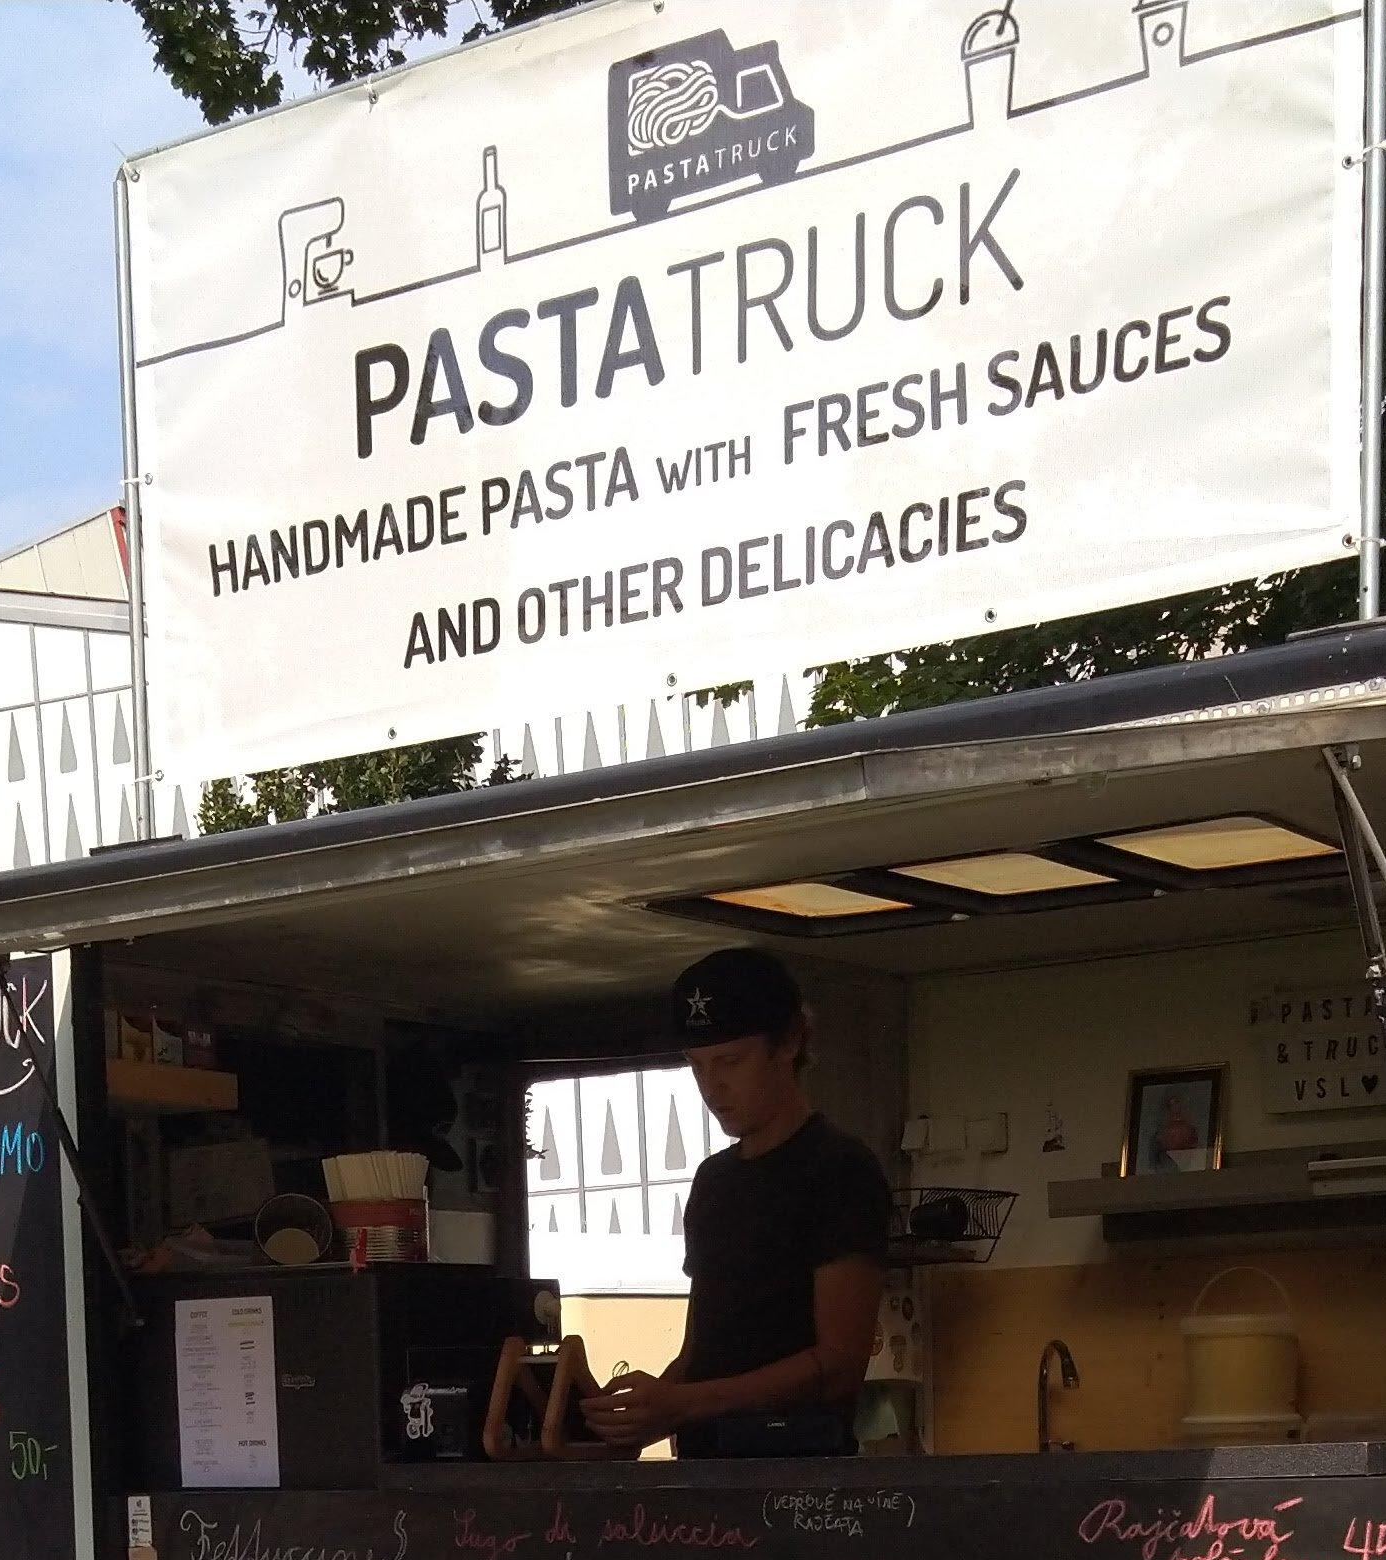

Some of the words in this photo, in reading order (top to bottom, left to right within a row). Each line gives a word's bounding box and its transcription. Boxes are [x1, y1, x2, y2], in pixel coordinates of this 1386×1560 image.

[625, 124, 801, 196] PASTATRUCK
[356, 167, 1025, 459] PASTATRUCK
[208, 485, 469, 598] HANDMADE
[481, 446, 638, 537] PASTA
[781, 369, 968, 467] FRESH
[986, 295, 1233, 418] SAUCES
[404, 594, 501, 669] AND
[517, 554, 685, 644] OTHER
[699, 478, 1030, 609] DELICACIES
